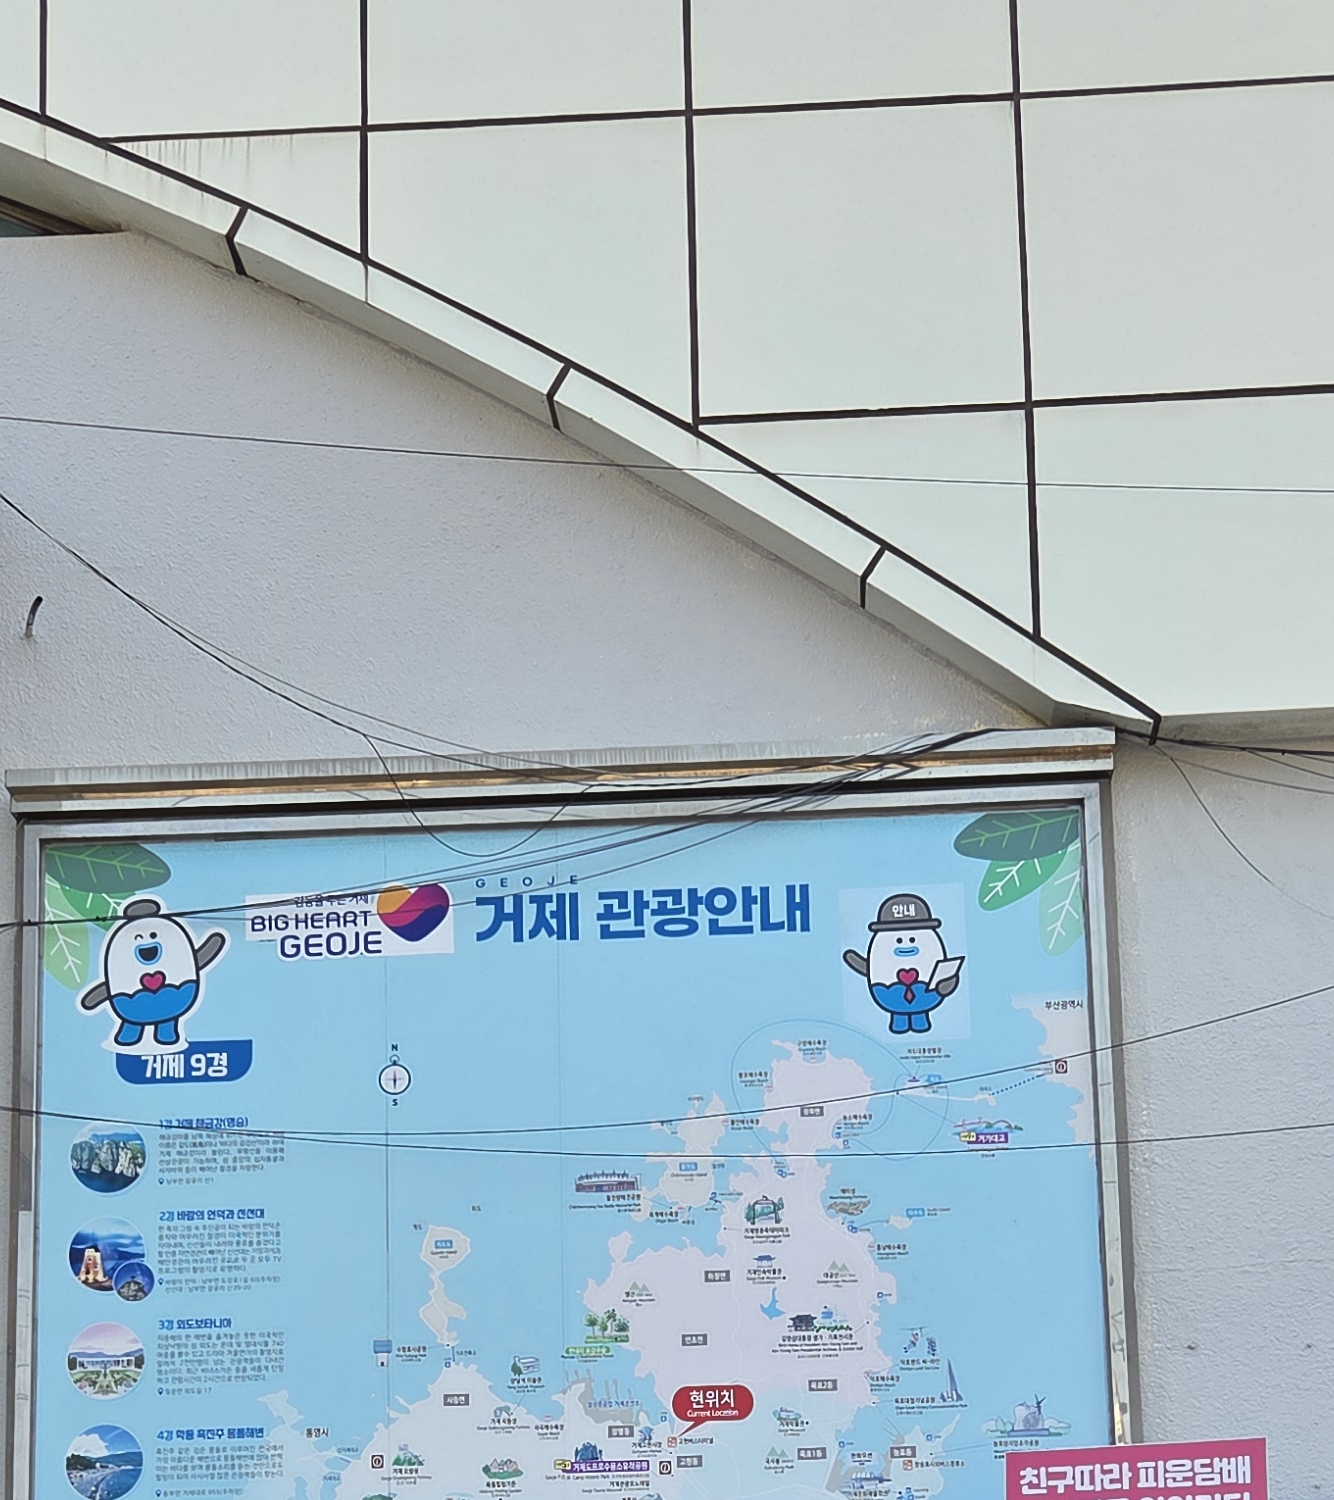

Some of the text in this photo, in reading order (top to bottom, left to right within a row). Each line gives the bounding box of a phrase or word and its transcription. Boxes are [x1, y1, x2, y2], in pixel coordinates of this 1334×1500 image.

[474, 873, 579, 889] GEOJE
[475, 883, 811, 943] 거제 관광안내
[891, 902, 917, 919] 안내
[250, 909, 373, 933] BIG HEART
[279, 929, 383, 959] GEOJE
[1044, 998, 1084, 1012] 부산광역시
[391, 1043, 399, 1052] N
[141, 1052, 229, 1080] 거제 9경
[391, 1098, 399, 1107] S
[176, 1209, 205, 1222] 바람의
[206, 1208, 235, 1221] 언덕과
[175, 1317, 233, 1330] 외도보타니아
[688, 1388, 736, 1409] 현위치
[686, 1407, 740, 1419] Current Location
[305, 1427, 330, 1439] 통영시
[1019, 1455, 1252, 1495] 친구따라 피운담배
